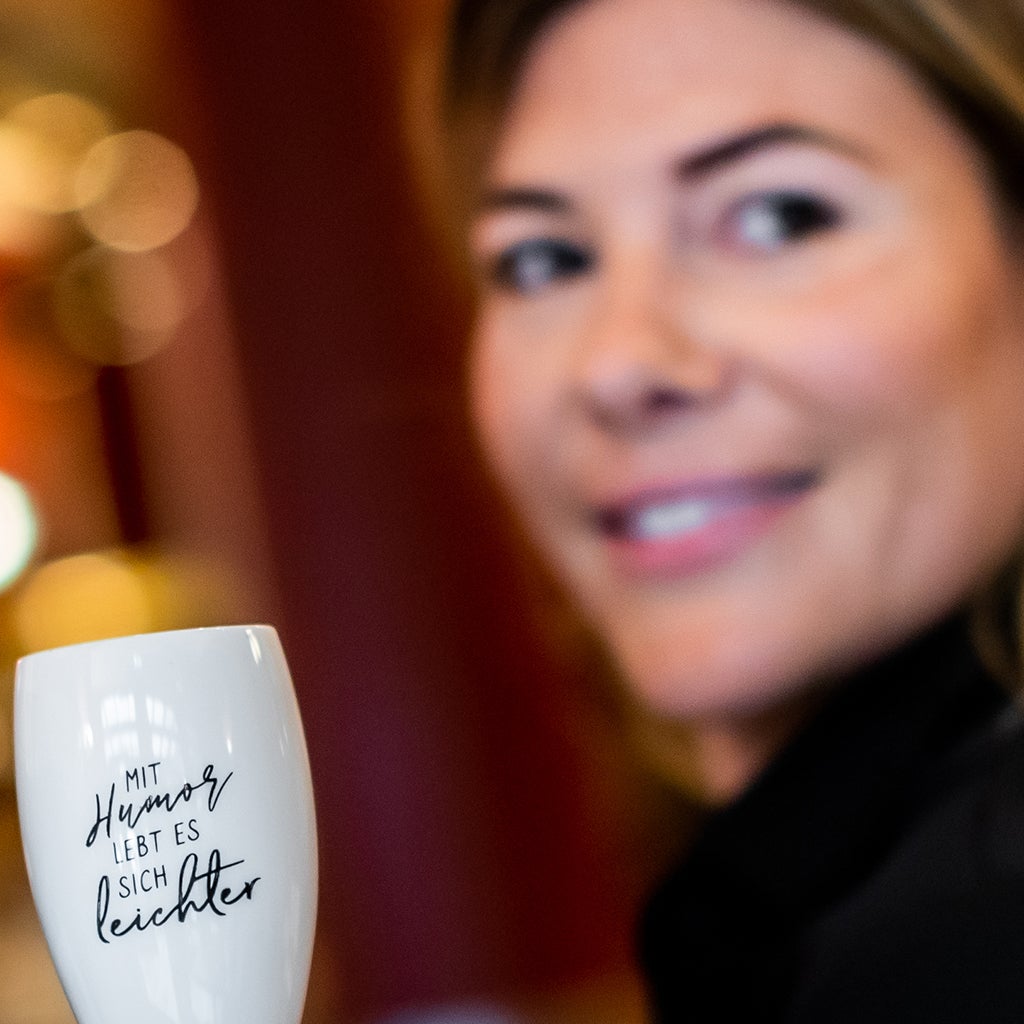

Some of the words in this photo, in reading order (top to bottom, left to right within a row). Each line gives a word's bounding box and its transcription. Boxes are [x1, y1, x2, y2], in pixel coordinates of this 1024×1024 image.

[125, 762, 161, 792] MIT
[85, 764, 234, 848] Humor
[112, 830, 162, 864] LEBT
[174, 819, 200, 845] ES
[96, 849, 261, 944] leichter
[118, 865, 167, 898] SICH
